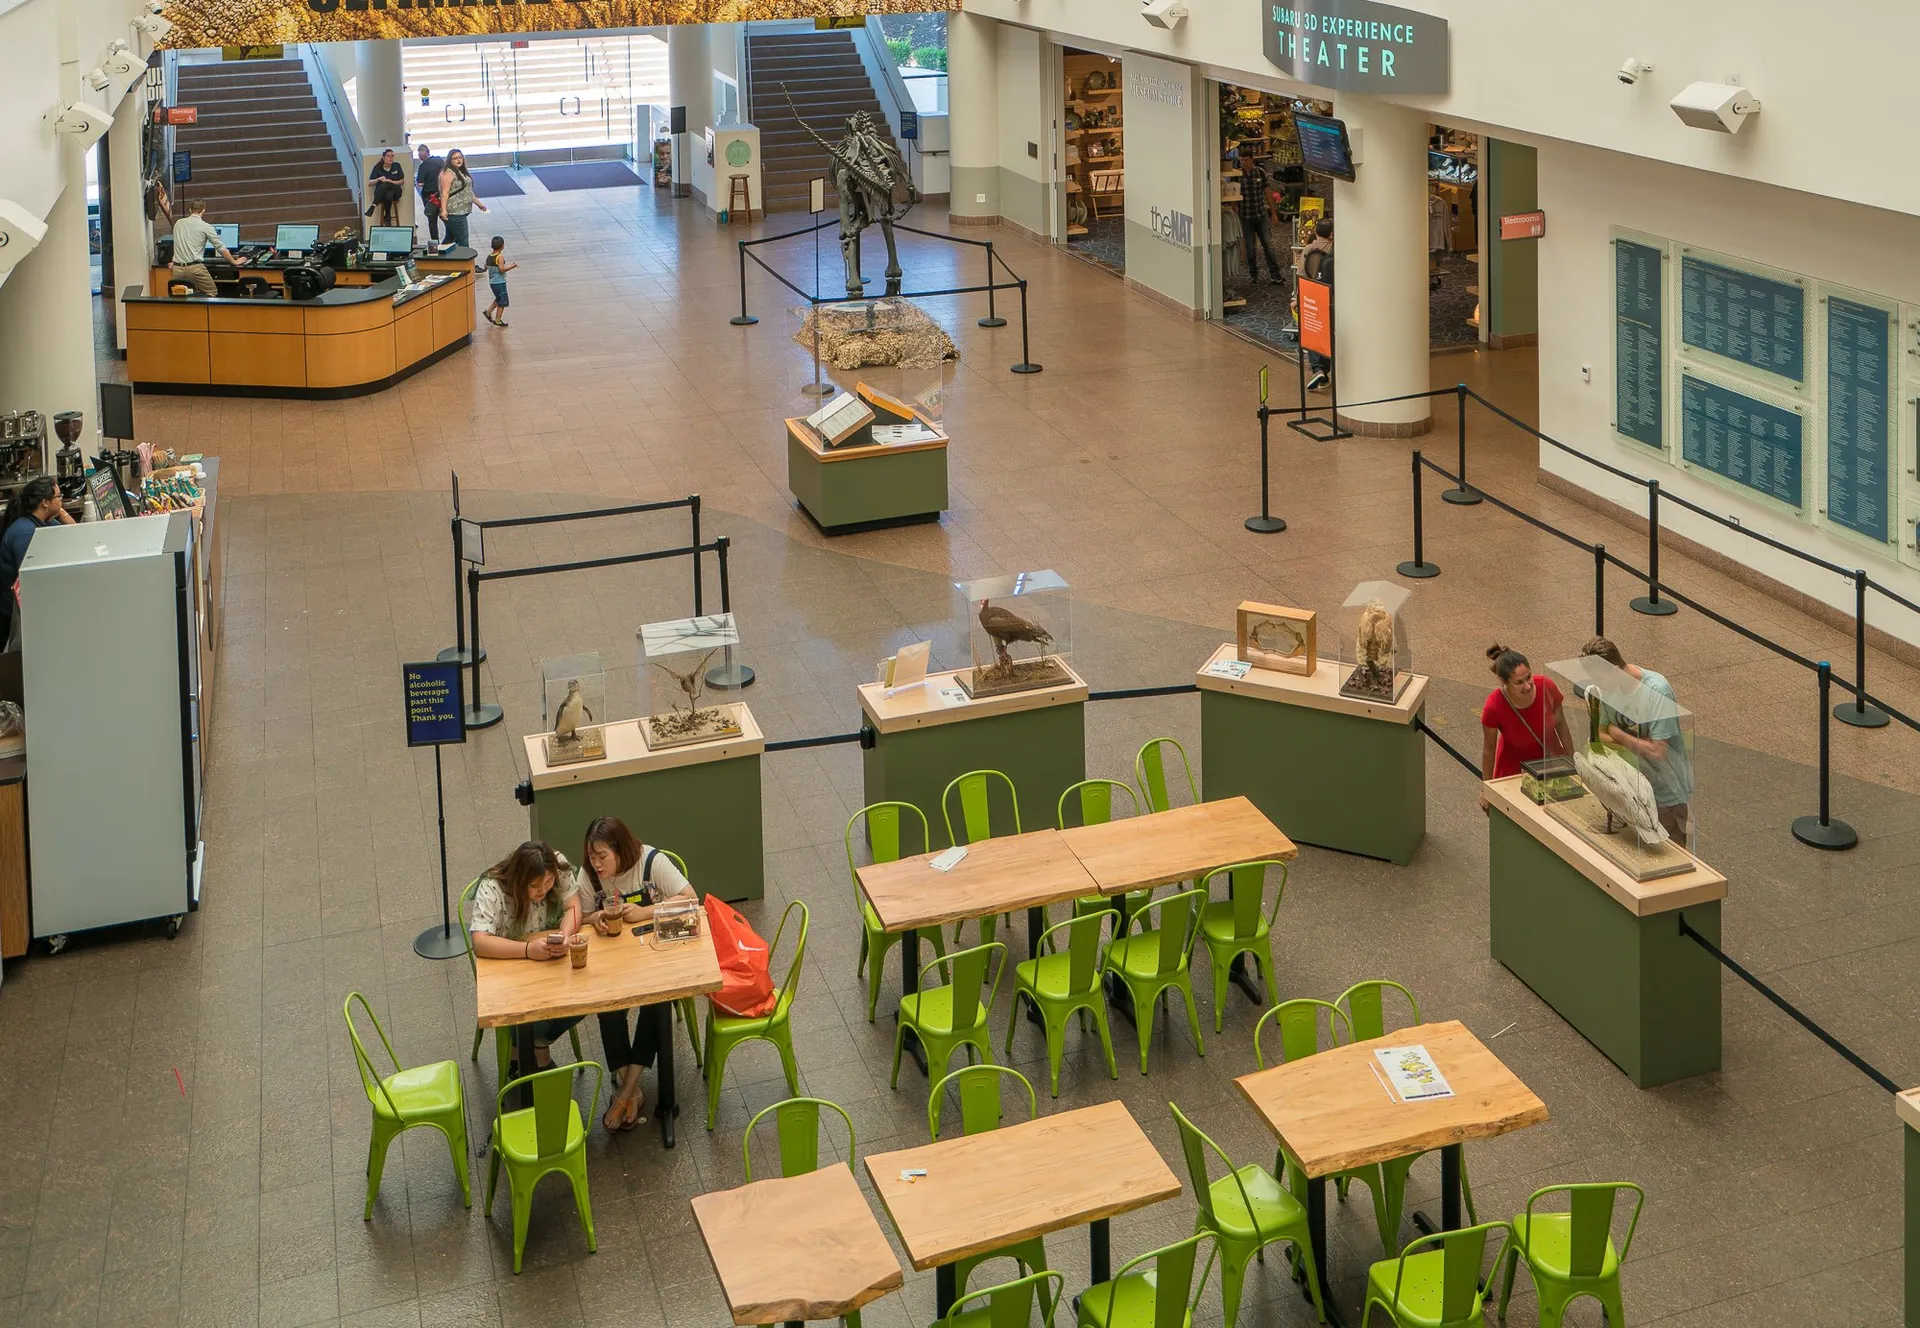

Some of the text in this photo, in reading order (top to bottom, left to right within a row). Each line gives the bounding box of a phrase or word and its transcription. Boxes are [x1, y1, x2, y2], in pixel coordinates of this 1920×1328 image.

[1272, 5, 1414, 44] SUBARU 3D EXPERIENCE
[1278, 31, 1396, 77] THEATER
[1130, 84, 1184, 108] MUSEUM STORE
[1504, 215, 1540, 225] Restrooms
[409, 680, 446, 688] alcoholic
[410, 688, 450, 697] beverages
[411, 698, 427, 707] past
[411, 706, 434, 715] point.
[412, 713, 456, 722] Thank you.
